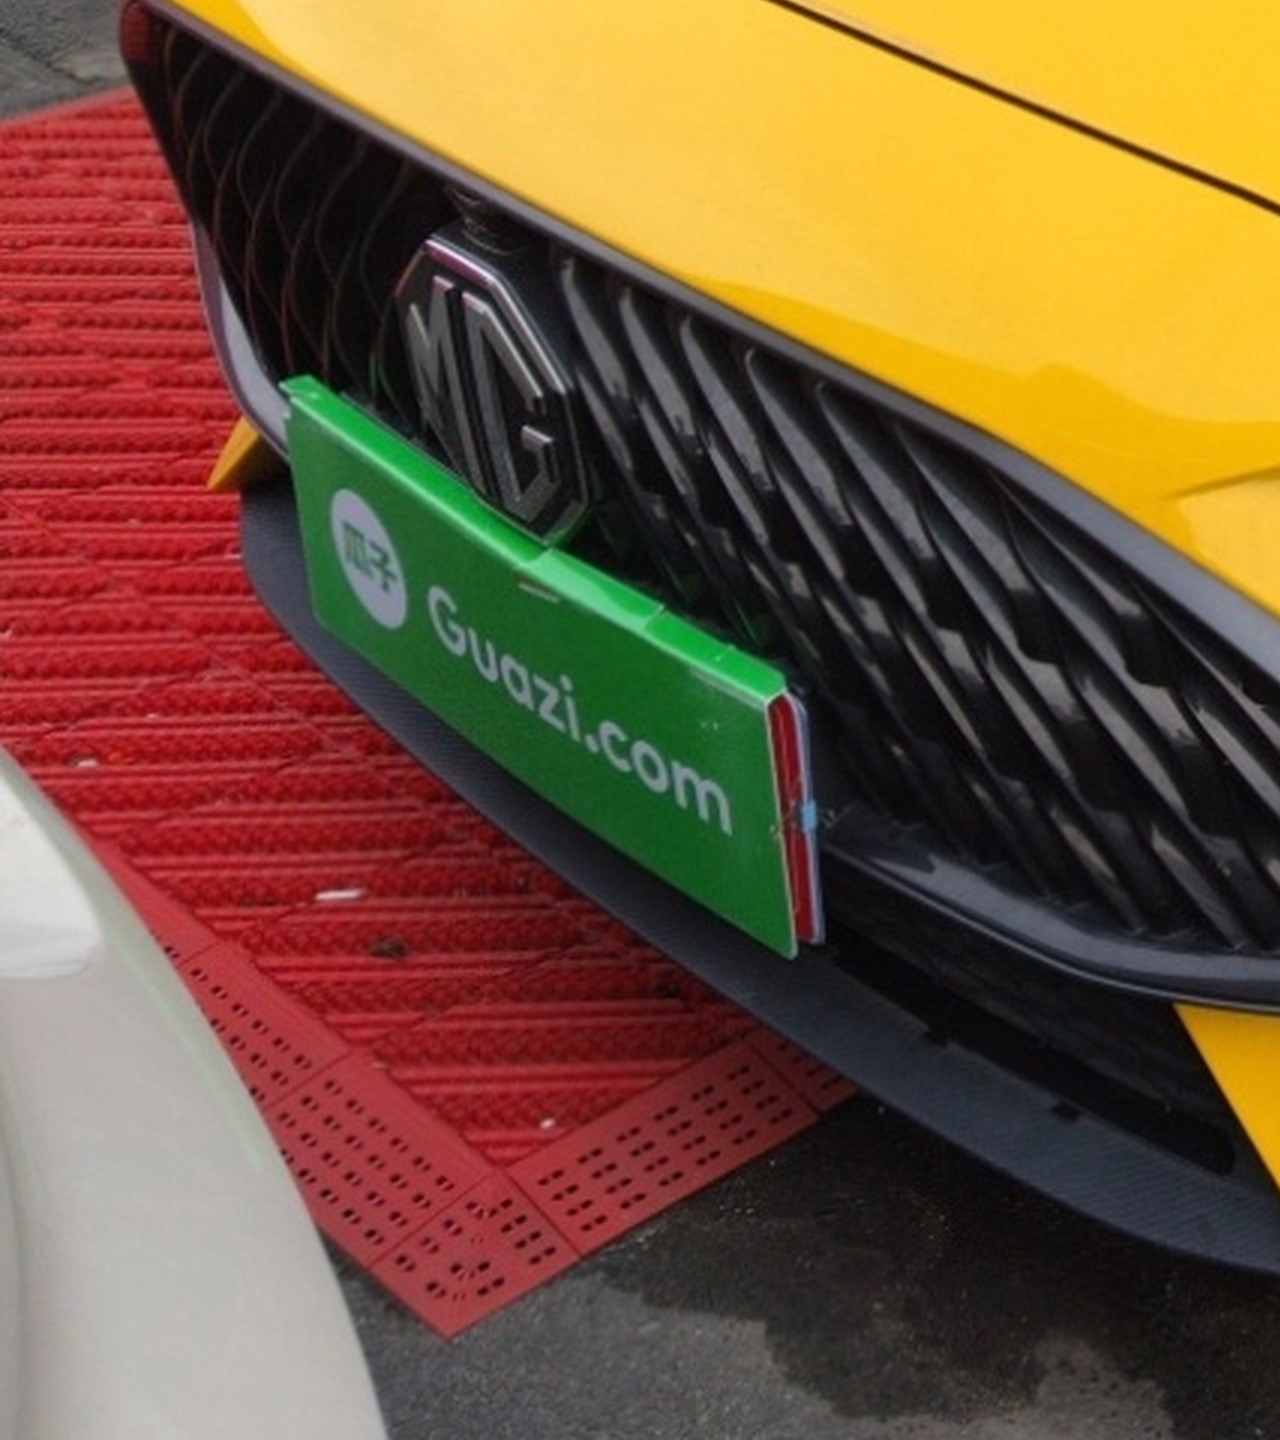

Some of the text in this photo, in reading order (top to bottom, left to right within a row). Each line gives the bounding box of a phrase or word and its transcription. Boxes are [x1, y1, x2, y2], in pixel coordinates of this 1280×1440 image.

[406, 274, 560, 522] MG
[341, 520, 398, 594] 瓜子
[427, 584, 734, 837] Guazi.com
